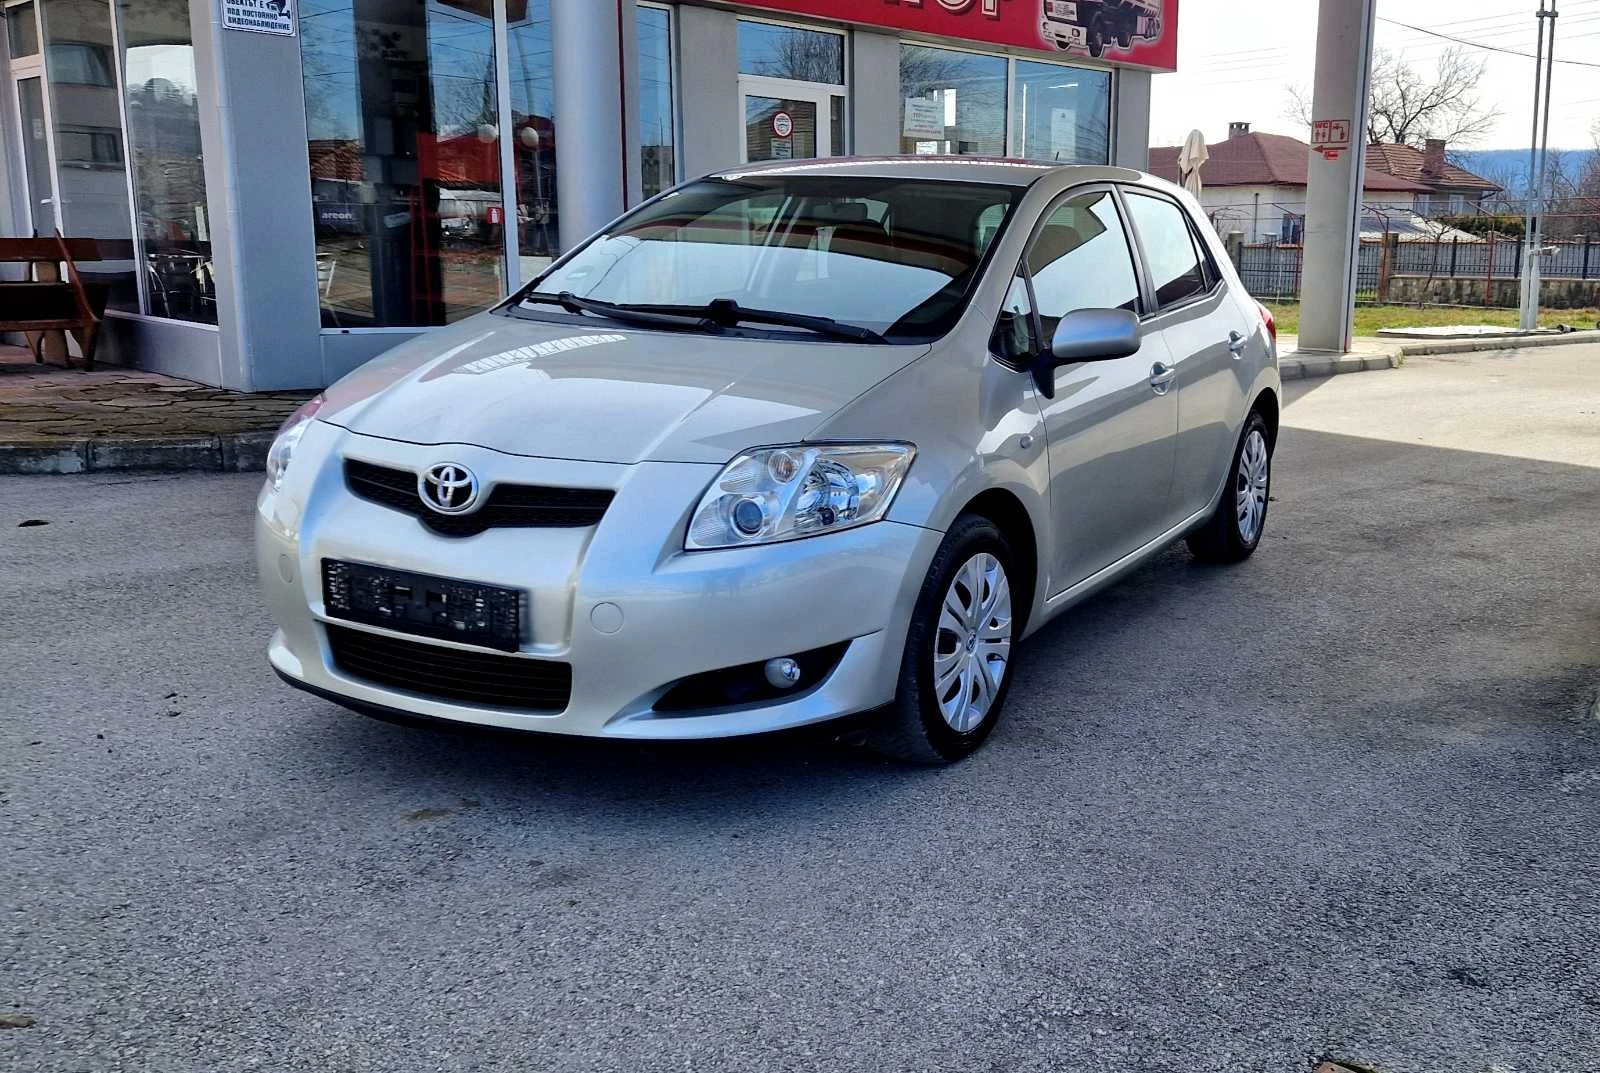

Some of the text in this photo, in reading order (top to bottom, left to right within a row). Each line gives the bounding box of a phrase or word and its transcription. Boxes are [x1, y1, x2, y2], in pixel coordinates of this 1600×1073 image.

[227, 8, 278, 20] ПОД ПОСТОЯННО
[228, 17, 290, 30] ВИДЕОНАБЛЮДЕНИЕ
